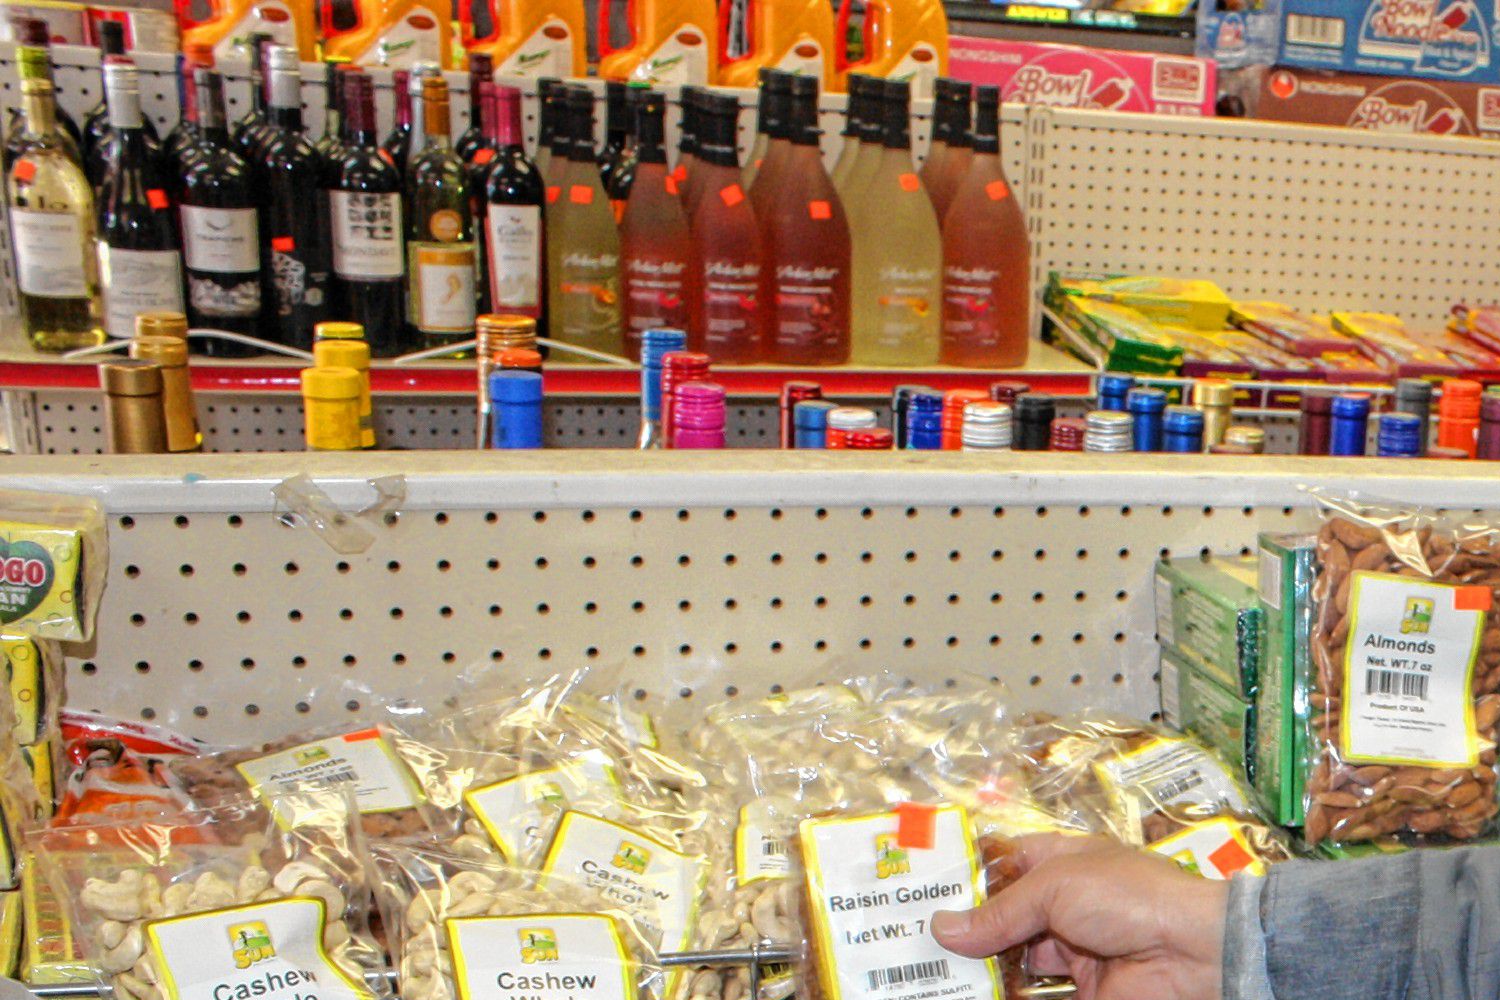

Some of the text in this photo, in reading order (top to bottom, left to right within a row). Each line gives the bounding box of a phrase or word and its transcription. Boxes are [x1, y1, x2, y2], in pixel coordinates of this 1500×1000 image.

[1016, 64, 1093, 106] Bowl
[1364, 633, 1436, 654] Almonds
[1420, 663, 1433, 672] oz
[269, 757, 348, 781] Almonds
[830, 881, 963, 913] Raisin Golden
[881, 920, 912, 940] Wt.
[916, 919, 926, 935] 7
[497, 971, 597, 991] Cashew
